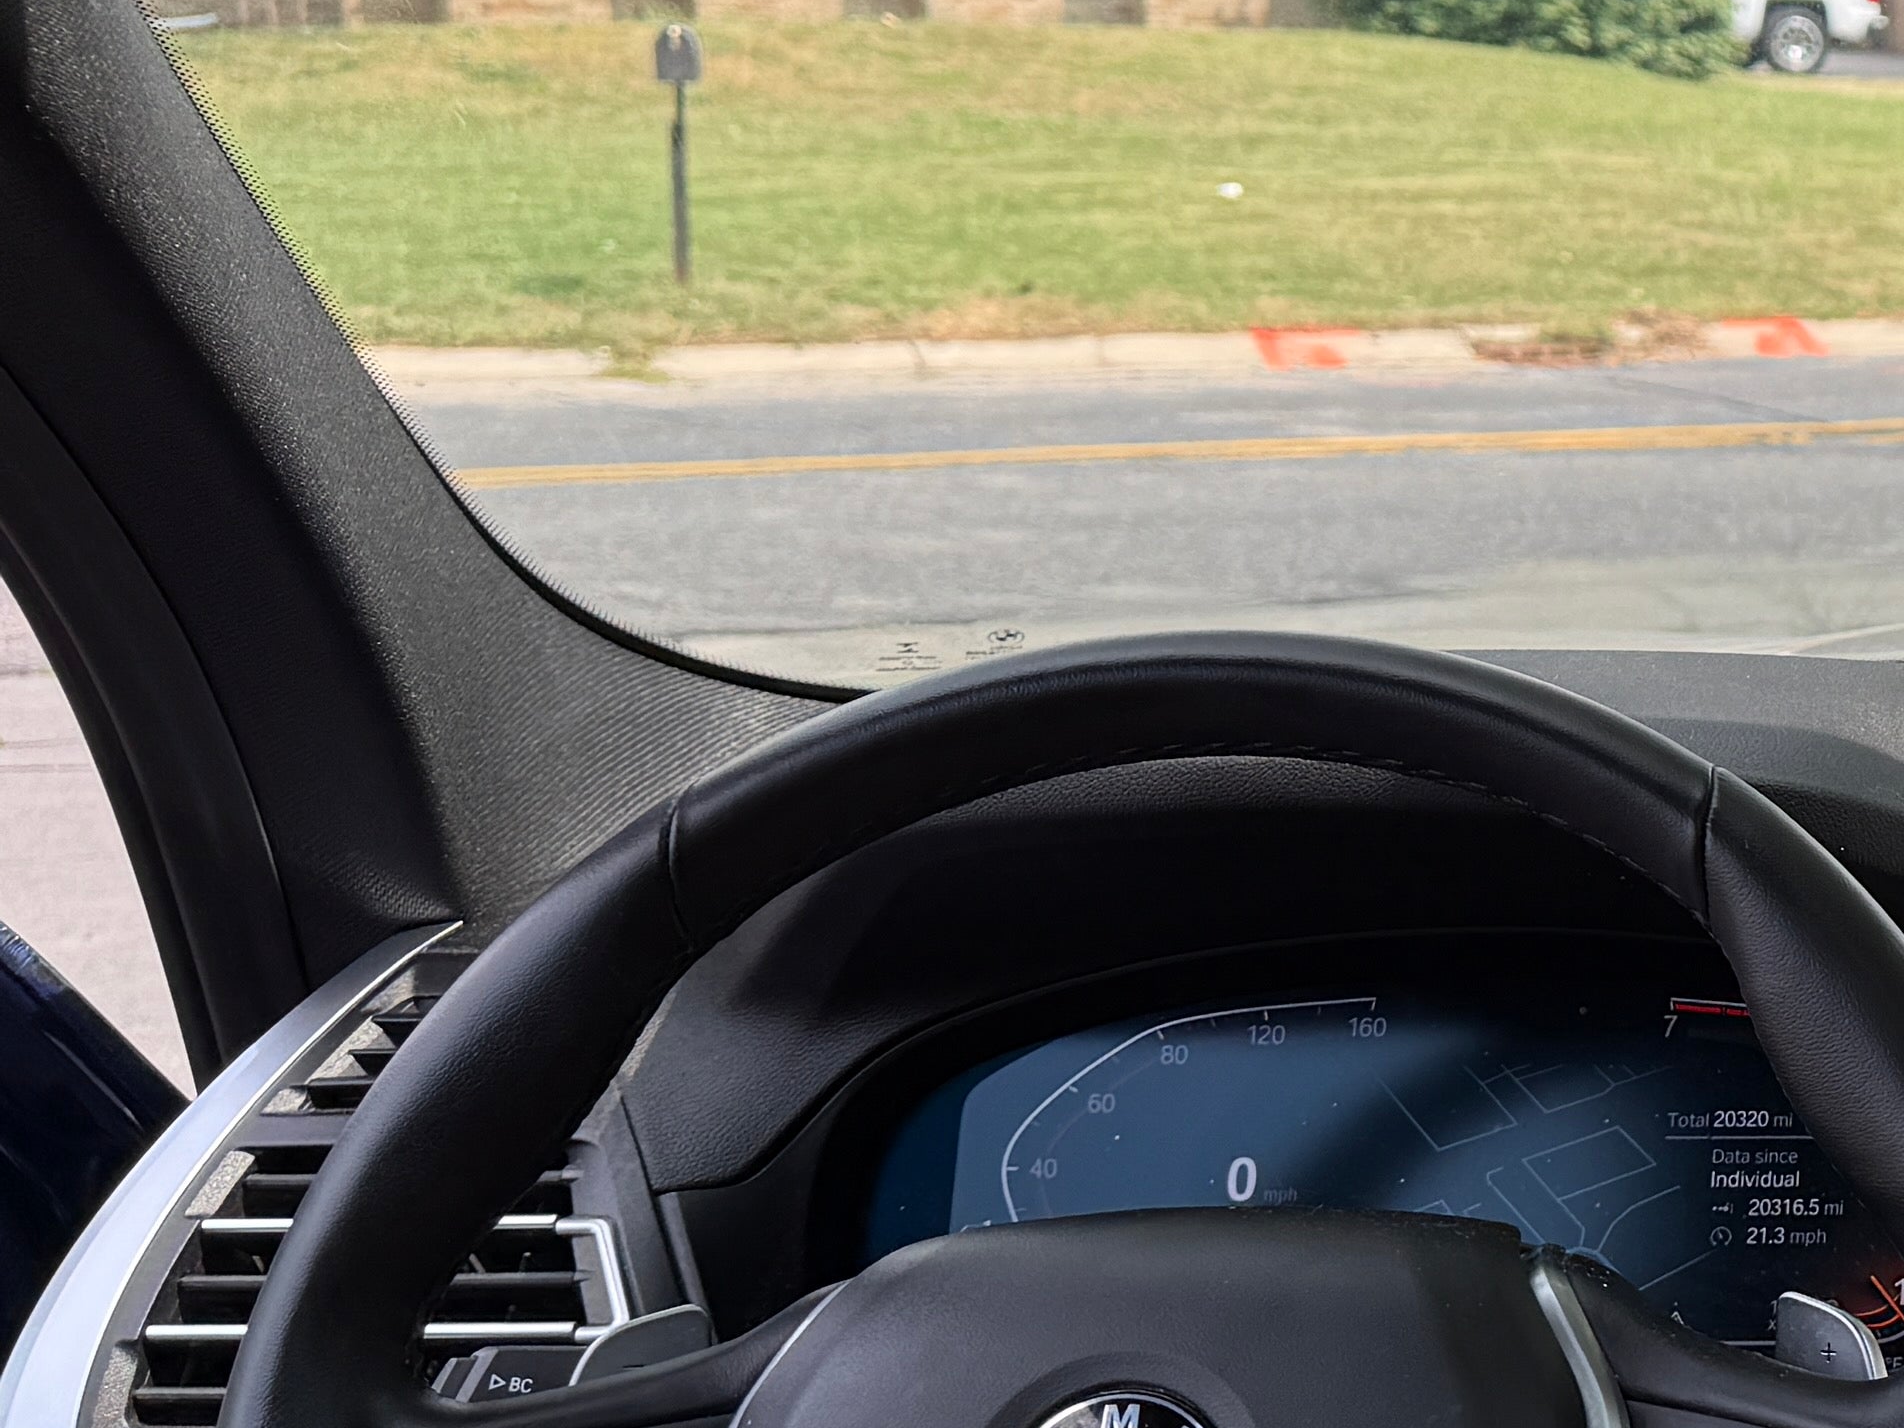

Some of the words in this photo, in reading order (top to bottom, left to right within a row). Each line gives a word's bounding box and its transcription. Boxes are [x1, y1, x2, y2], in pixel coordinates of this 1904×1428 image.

[1246, 1024, 1286, 1046] 120
[1347, 1016, 1388, 1038] 160
[1663, 1014, 1678, 1039] 7
[1160, 1044, 1189, 1066] 80
[1087, 1093, 1116, 1114] 60
[1667, 1111, 1711, 1129] Total
[1713, 1110, 1770, 1128] 20320
[1773, 1111, 1793, 1128] mi
[1711, 1148, 1751, 1165] Data
[1754, 1148, 1799, 1165] since
[1029, 1158, 1058, 1179] 40
[1710, 1170, 1801, 1188] Individual
[1226, 1156, 1258, 1202] 0
[1263, 1186, 1299, 1205] mph
[1747, 1198, 1821, 1217] 20316.5
[1823, 1198, 1845, 1216] mi
[1746, 1227, 1786, 1245] 21.3
[1789, 1228, 1828, 1246] mph
[507, 1375, 534, 1395] BC
